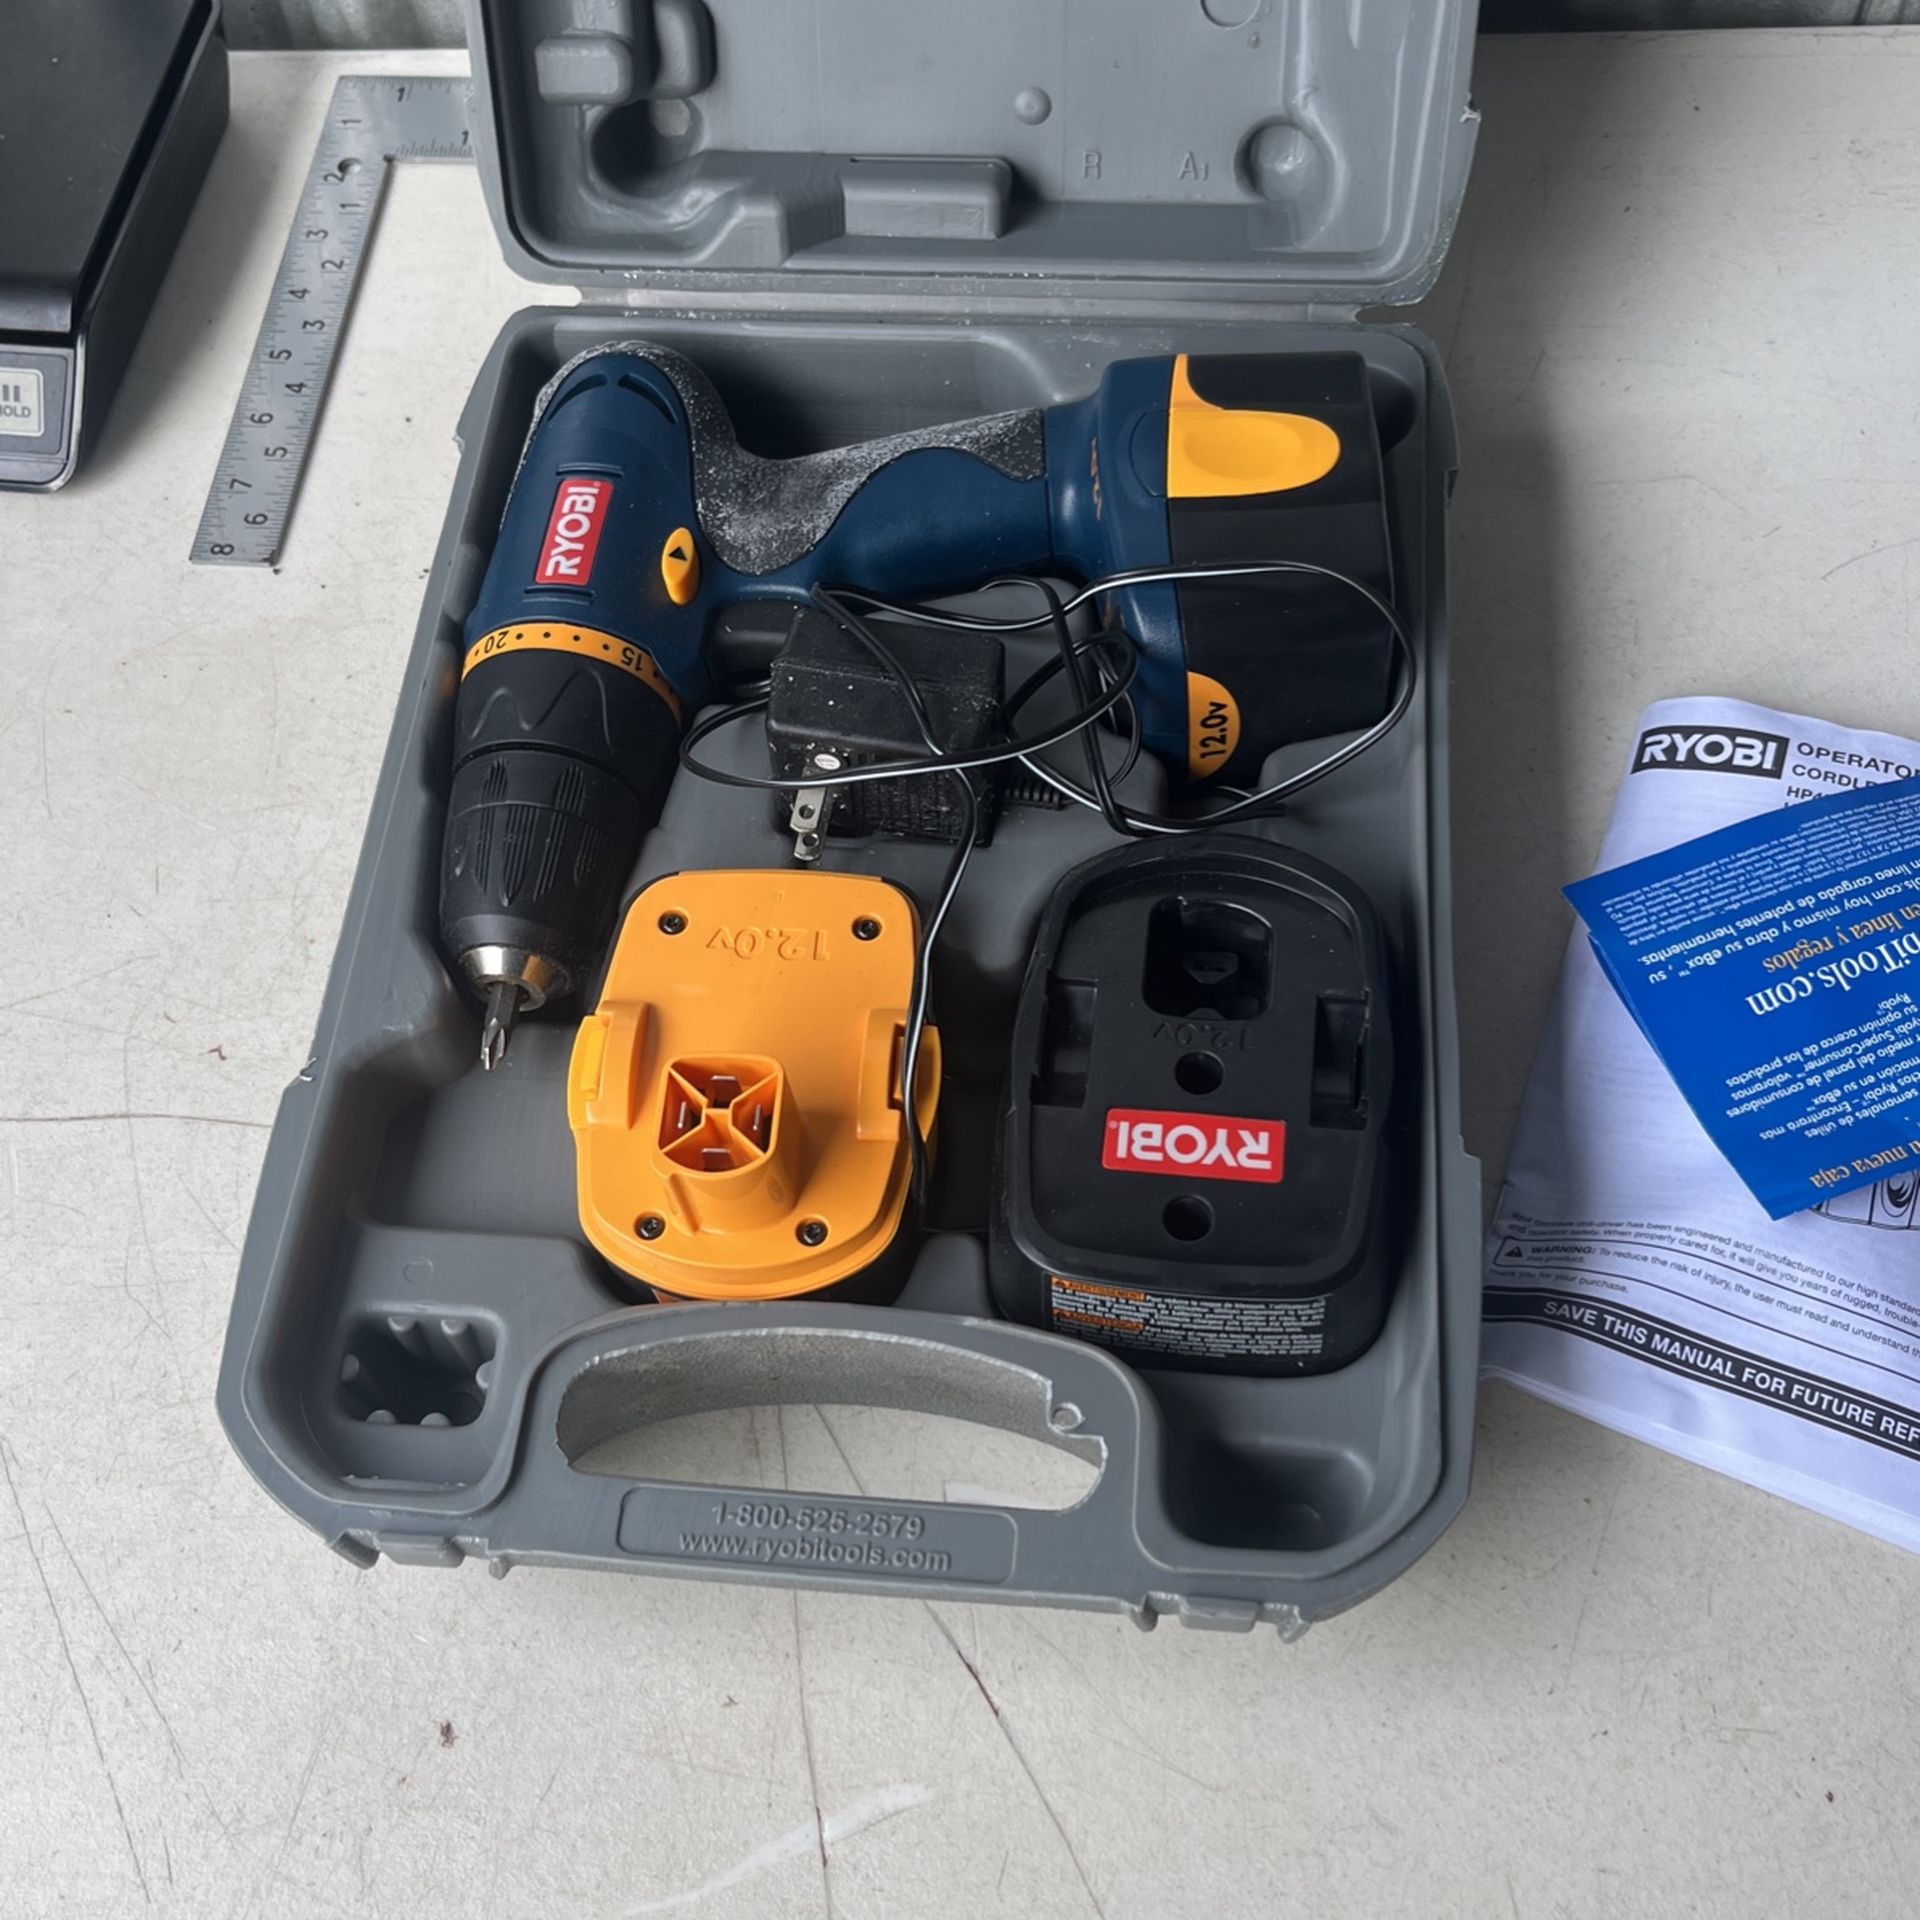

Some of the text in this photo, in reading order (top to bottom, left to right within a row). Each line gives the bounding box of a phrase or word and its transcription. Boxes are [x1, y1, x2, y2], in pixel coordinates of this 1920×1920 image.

[323, 171, 345, 183] 2
[306, 228, 328, 240] 3
[321, 259, 344, 270] 2
[288, 288, 311, 300] 4
[302, 319, 325, 331] 3
[269, 349, 292, 361] 5
[284, 381, 307, 394] 4
[250, 412, 274, 425] 6
[264, 446, 288, 459] 5
[229, 478, 252, 490] 7
[244, 512, 268, 526] 6
[210, 543, 235, 556] 8
[483, 630, 510, 654] 20
[621, 645, 644, 672] 15
[1796, 742, 1920, 778] OPERATO
[1817, 877, 1873, 902] cargada
[1871, 877, 1920, 901] ols.com
[1797, 896, 1816, 910] de
[1843, 893, 1873, 912] hoy
[1735, 901, 1795, 931] potentes
[1793, 905, 1841, 929] mismo
[1849, 911, 1903, 940] línea
[1782, 921, 1792, 933] y
[1835, 926, 1850, 946] y
[1637, 925, 1738, 967] herramientas.
[1746, 929, 1780, 947] abra
[1724, 942, 1744, 955] su
[1762, 936, 1835, 973] regalos
[1648, 969, 1668, 985] su
[1745, 932, 1920, 1015] biTools.com
[1903, 1003, 1919, 1016] su
[1894, 1017, 1920, 1038] yobi
[1821, 1028, 1858, 1049] acerca
[1877, 1036, 1914, 1057] medio
[1783, 1049, 1803, 1064] los
[1802, 1043, 1818, 1056] de
[1827, 1060, 1856, 1080] panel
[1857, 1053, 1876, 1069] del
[1877, 1055, 1920, 1080] mación
[1725, 1058, 1783, 1087] productos
[1806, 1076, 1821, 1089] de
[1858, 1075, 1876, 1087] en
[1731, 1071, 1793, 1101] valoramos
[1842, 1081, 1859, 1094] su
[1725, 1082, 1805, 1119] consumidores
[1838, 1113, 1854, 1127] de
[1852, 1145, 1908, 1174] nueva
[1809, 1164, 1850, 1189] caja
[1625, 1220, 1645, 1229] has
[1646, 1221, 1672, 1232] been
[1673, 1226, 1732, 1247] engineered
[1733, 1239, 1754, 1253] and
[1754, 1245, 1830, 1279] manufactured
[1826, 1271, 1837, 1282] to
[1837, 1276, 1856, 1290] our
[1857, 1281, 1879, 1303] high
[1603, 1229, 1632, 1238] When
[1633, 1229, 1677, 1245] properly
[1678, 1236, 1709, 1251] cared
[1710, 1244, 1727, 1260] for,
[1729, 1250, 1737, 1260] it
[1738, 1255, 1756, 1268] will
[1756, 1262, 1779, 1277] give
[1779, 1270, 1799, 1285] you
[1800, 1278, 1829, 1295] years
[1830, 1287, 1843, 1299] of
[1843, 1293, 1882, 1316] rugged,
[1554, 1274, 1578, 1282] your
[1578, 1277, 1630, 1294] purchase.
[1531, 1245, 1597, 1255] WARNING:
[1600, 1247, 1611, 1256] To
[1613, 1250, 1649, 1262] reduce
[1651, 1255, 1668, 1267] the
[1669, 1260, 1689, 1274] risk
[1690, 1267, 1703, 1278] of
[1703, 1271, 1732, 1291] injury,
[1734, 1283, 1751, 1296] the
[1752, 1291, 1776, 1305] user
[1776, 1299, 1803, 1315] must
[1804, 1309, 1829, 1325] read
[1829, 1318, 1850, 1332] and
[1851, 1324, 1911, 1355] understand
[1543, 1300, 1920, 1444] SAVE THIS MANUAL FOR FUTURE REF
[711, 1500, 926, 1540] 1-800-525-2579
[678, 1530, 952, 1573] www.ryobitools.com
